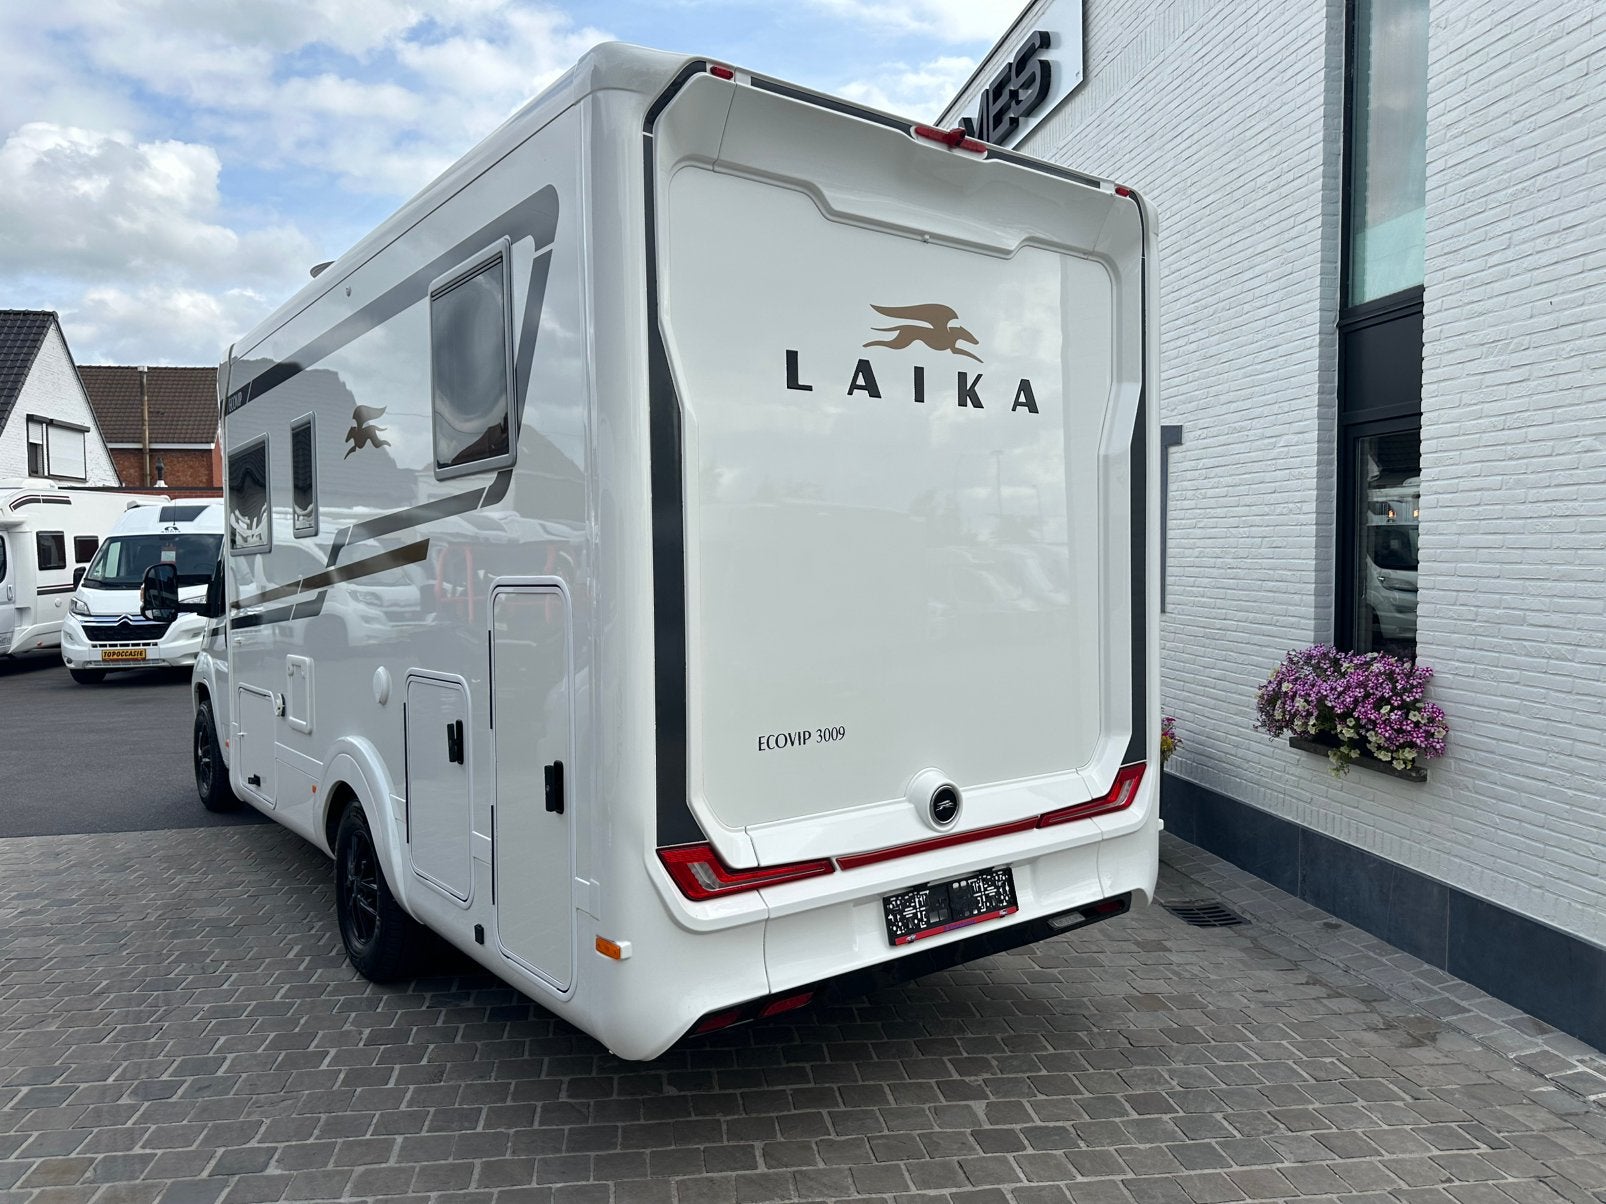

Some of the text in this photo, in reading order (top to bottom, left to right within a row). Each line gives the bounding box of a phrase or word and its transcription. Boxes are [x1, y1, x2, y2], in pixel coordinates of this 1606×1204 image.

[786, 349, 1039, 414] LAIKA
[103, 650, 144, 658] TOPOCCASIE
[758, 726, 845, 751] ECOVIP 3009
